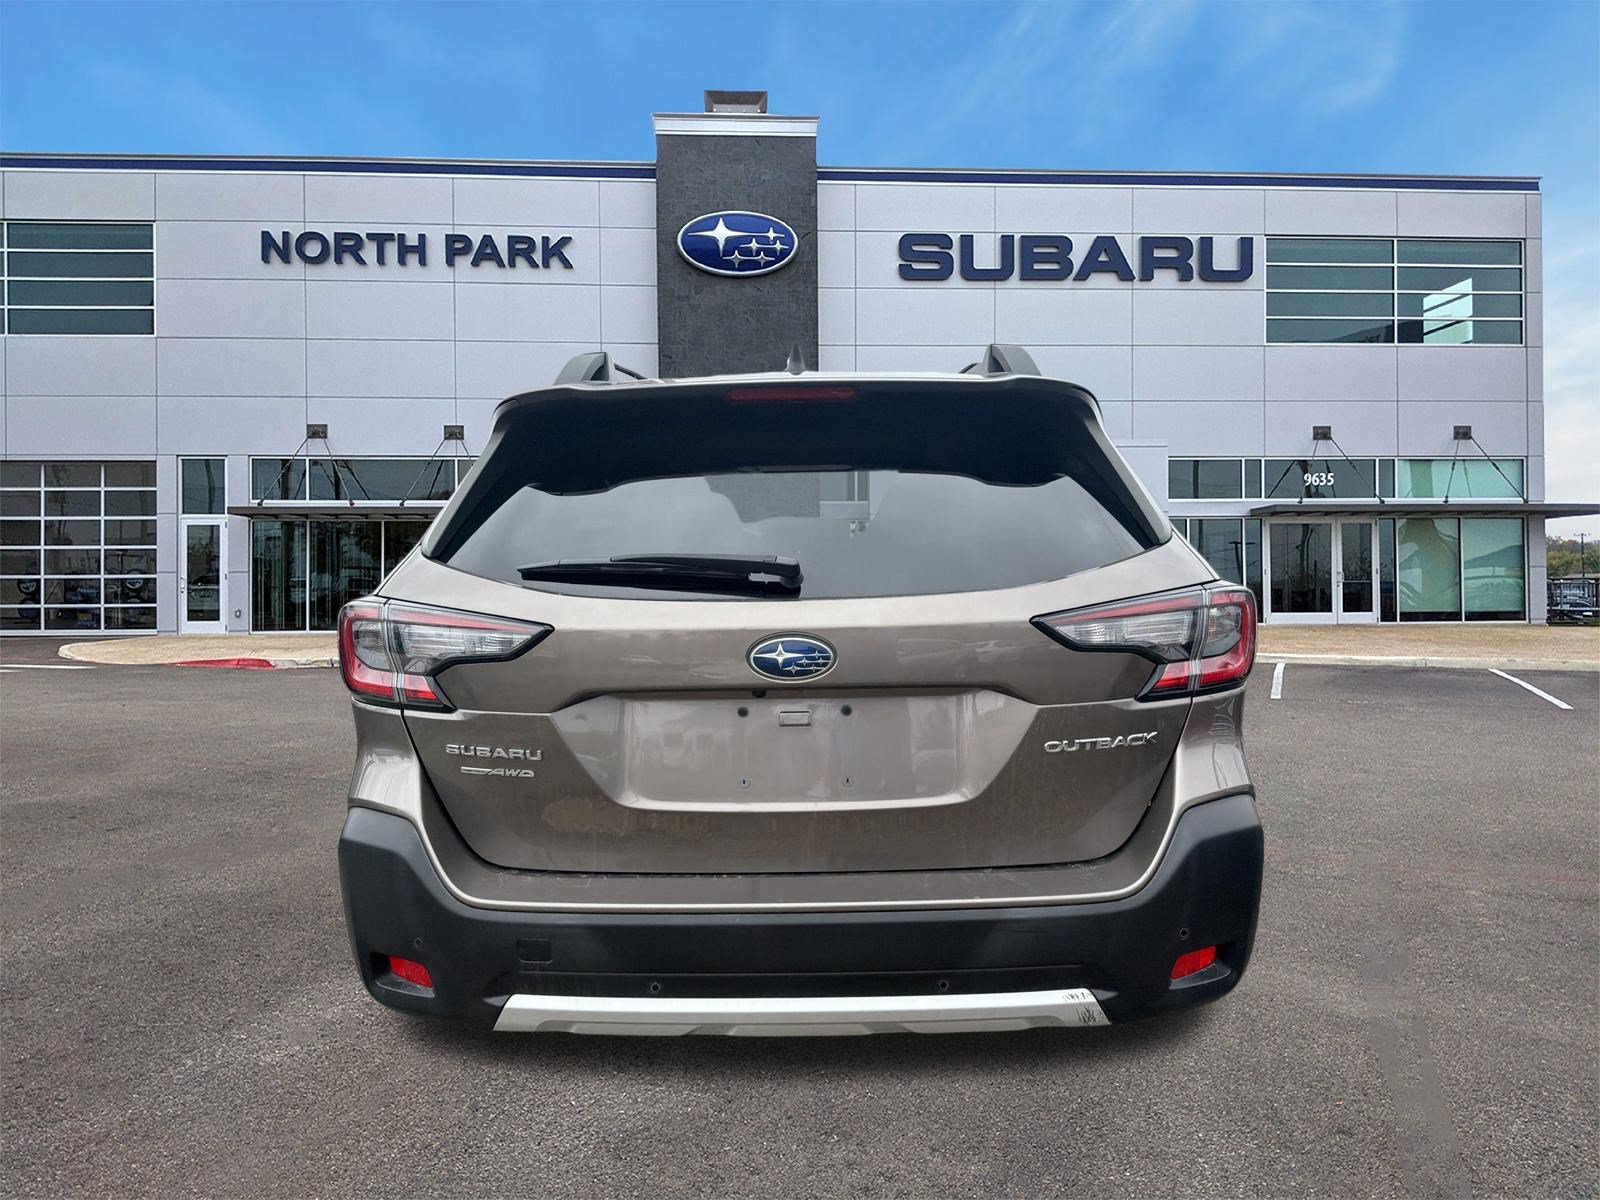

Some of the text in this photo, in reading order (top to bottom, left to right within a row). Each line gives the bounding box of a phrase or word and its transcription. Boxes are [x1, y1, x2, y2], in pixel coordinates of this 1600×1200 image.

[261, 230, 573, 269] NORTH PARK
[898, 233, 1254, 282] SUBARU
[1303, 472, 1335, 486] 9635
[1043, 731, 1158, 753] OUTBACK
[445, 744, 543, 761] SUBARU
[487, 768, 535, 778] AWD
